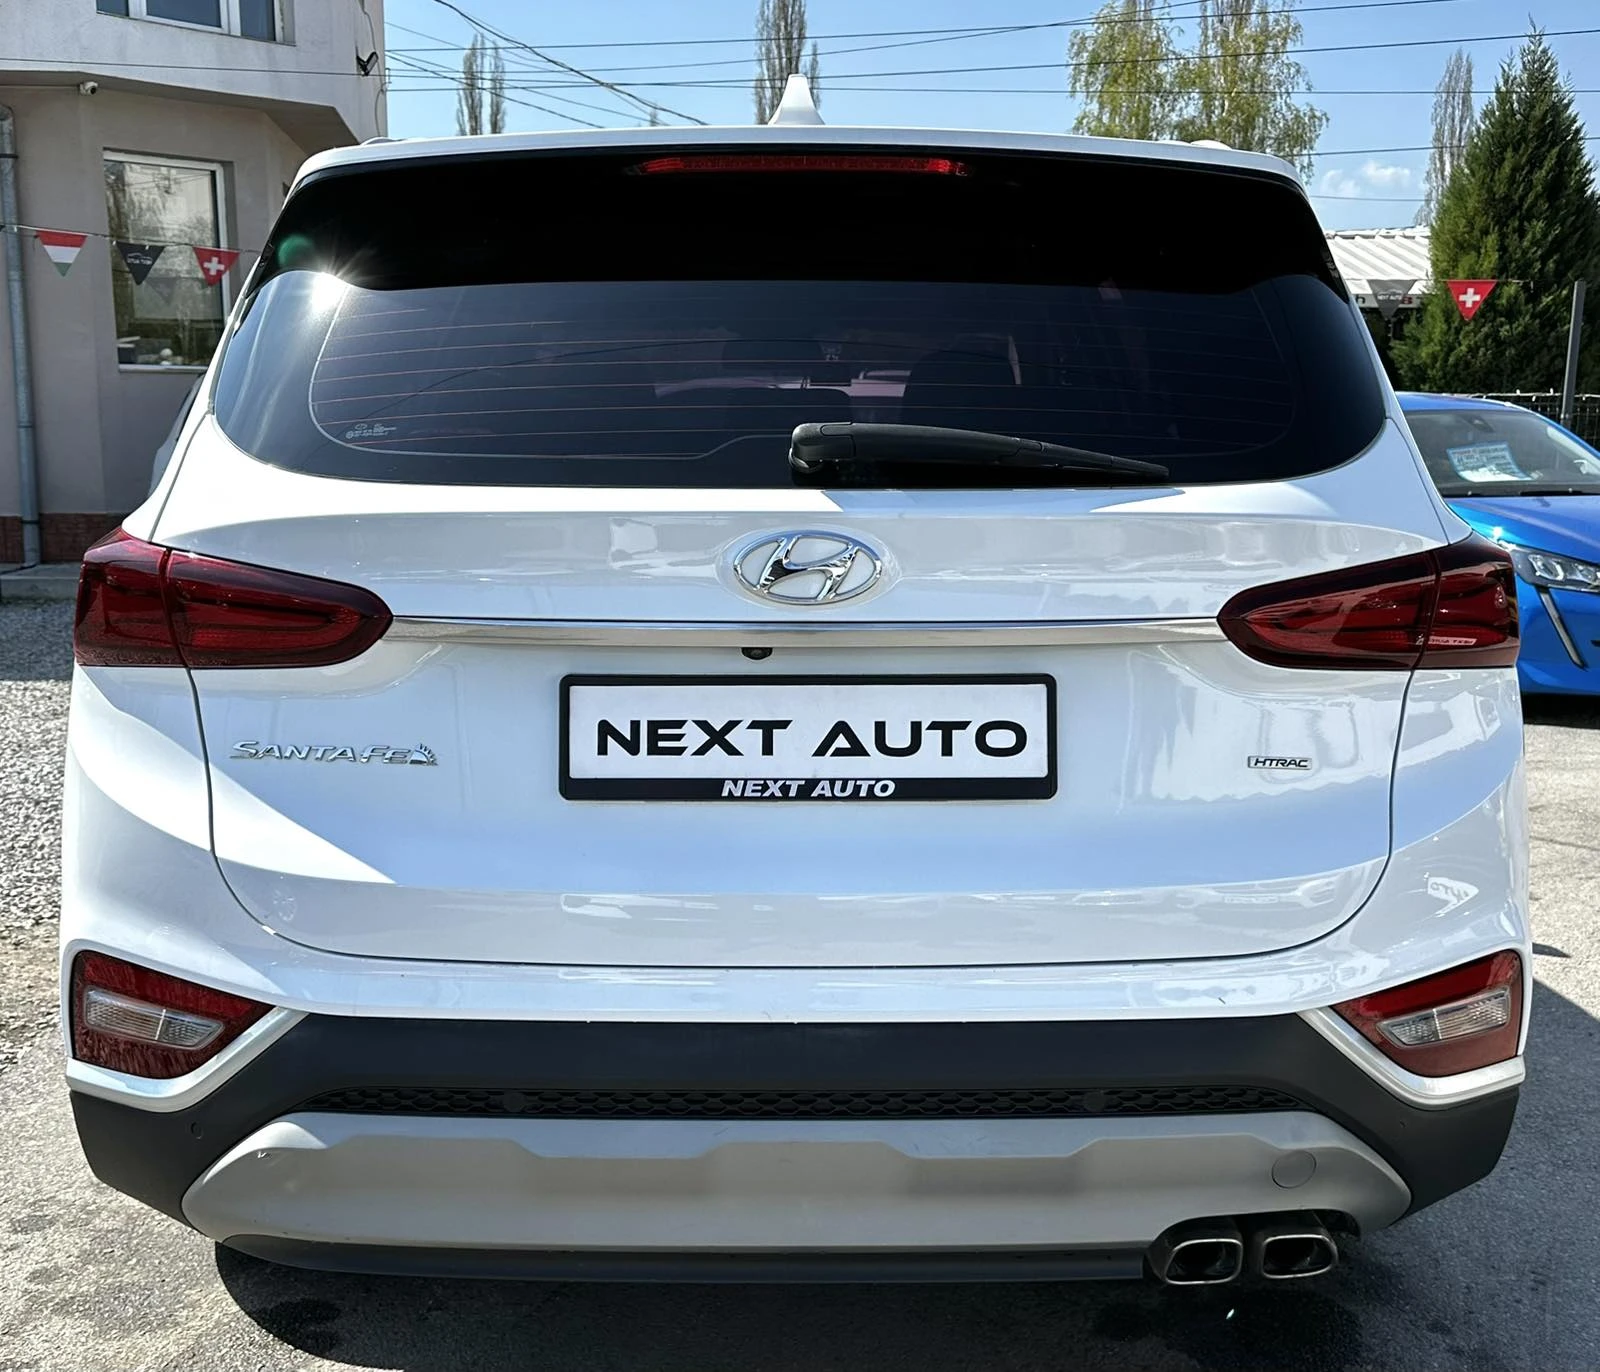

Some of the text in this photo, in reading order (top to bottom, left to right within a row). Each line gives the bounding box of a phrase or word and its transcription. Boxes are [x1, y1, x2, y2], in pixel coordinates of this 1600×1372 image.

[597, 719, 1028, 758] NEXT AUTO
[1253, 757, 1309, 768] HTRAC
[721, 779, 896, 797] NEXT AUTO
